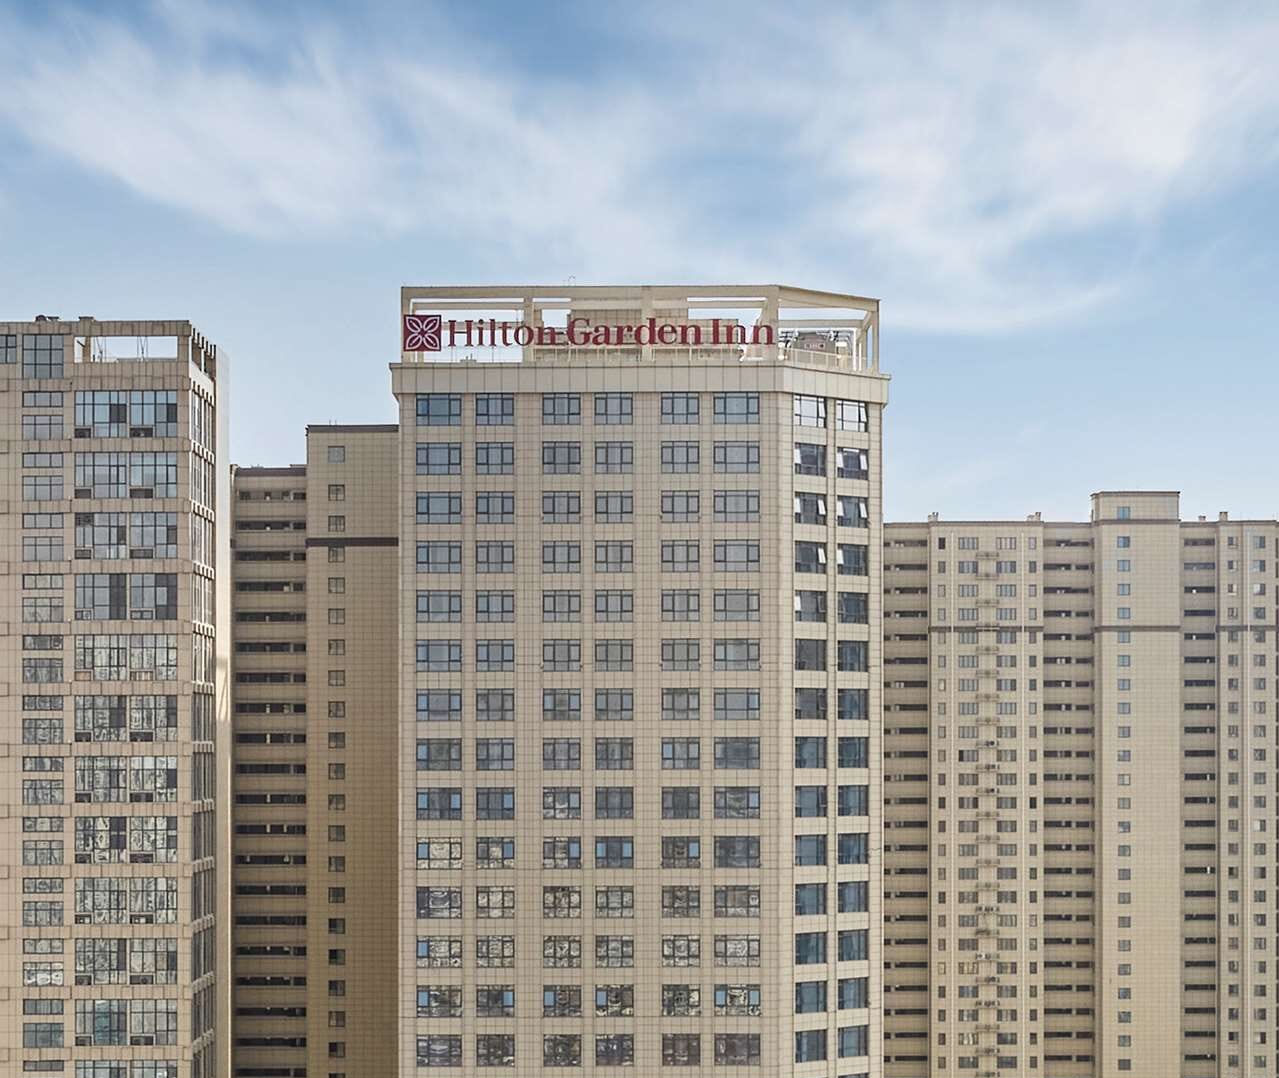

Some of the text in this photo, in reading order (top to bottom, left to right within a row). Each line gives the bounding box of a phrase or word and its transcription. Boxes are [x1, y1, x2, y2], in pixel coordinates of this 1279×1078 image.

[448, 317, 775, 348] Hilton Garden Inn
